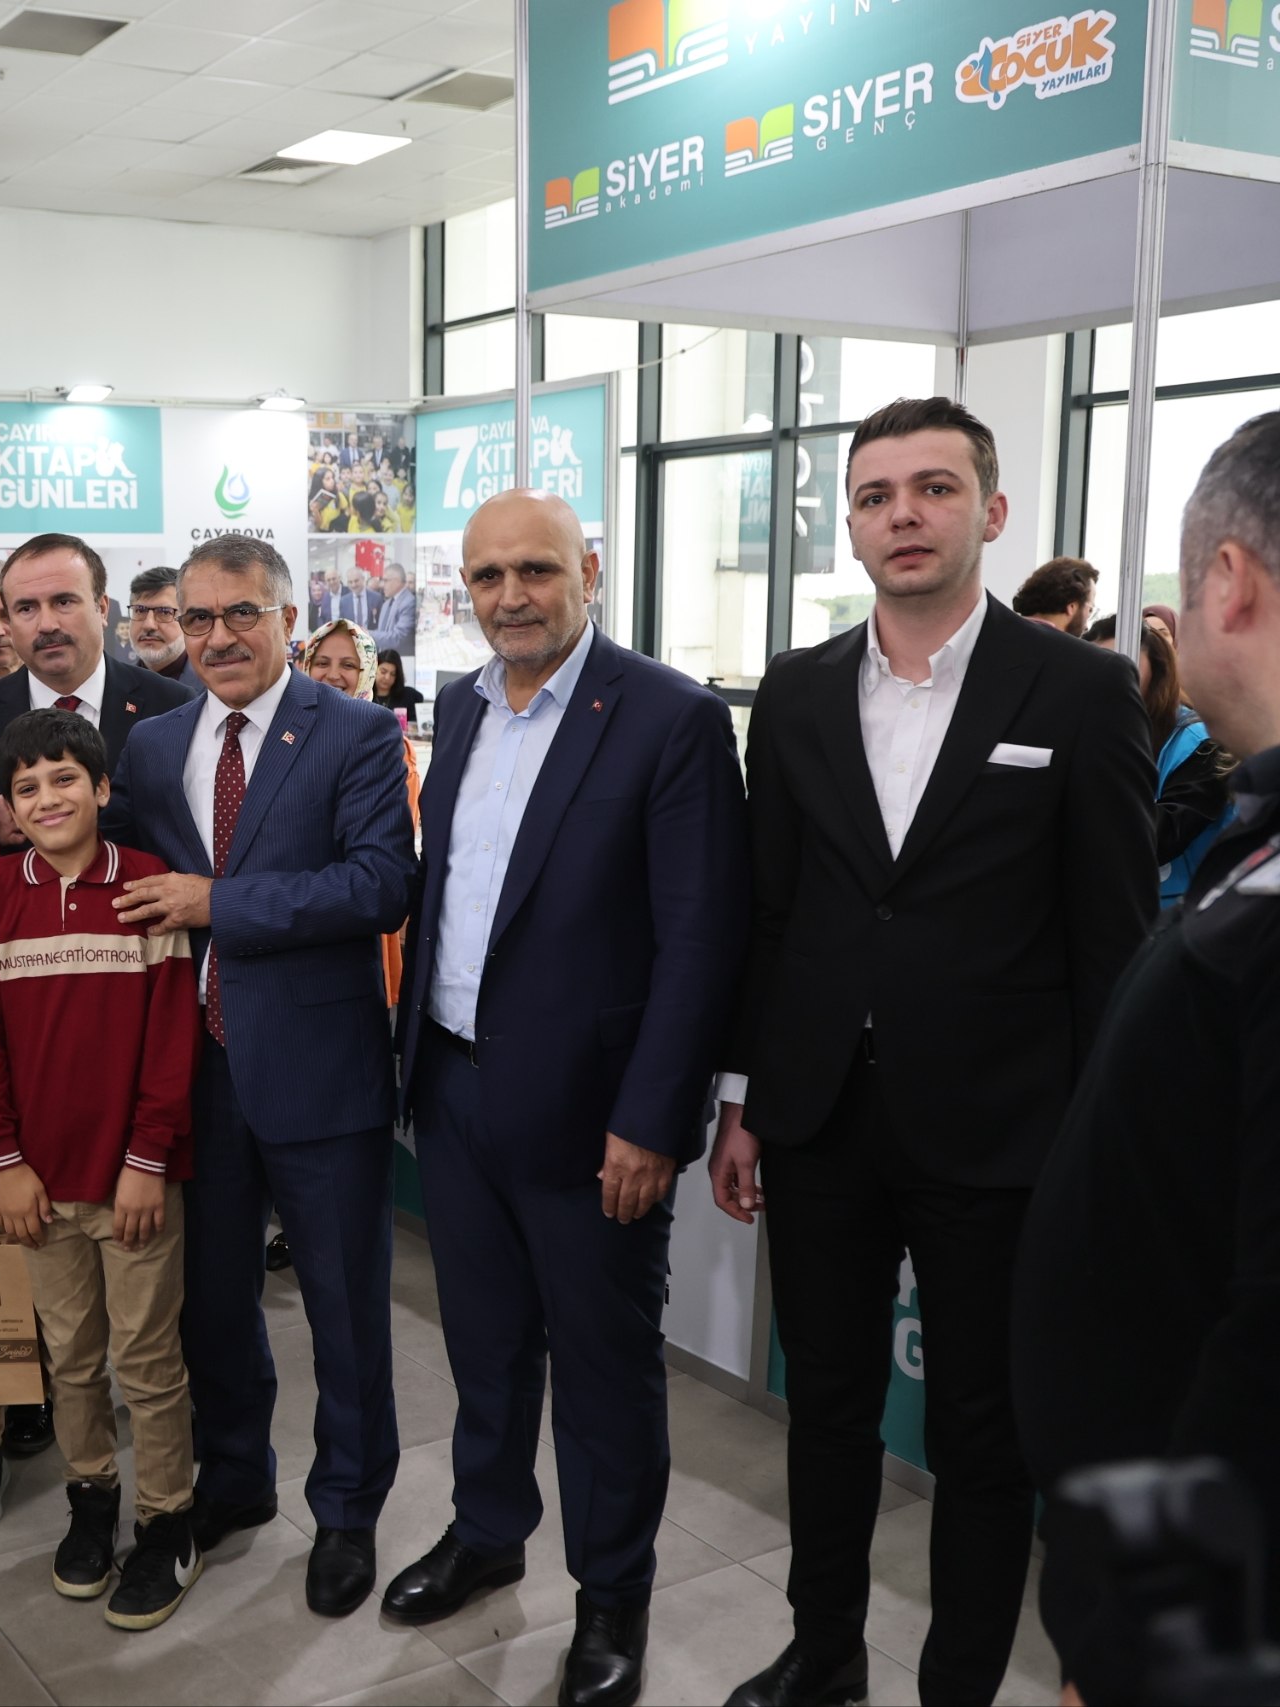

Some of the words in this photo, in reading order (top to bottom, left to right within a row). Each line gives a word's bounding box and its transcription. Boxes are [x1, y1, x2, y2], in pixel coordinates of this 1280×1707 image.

[744, 0, 901, 55] YAYIN
[1041, 62, 1107, 93] YAYINLARI
[816, 110, 917, 152] GENÇ
[605, 171, 704, 214] akademi
[434, 425, 477, 510] 7.
[476, 437, 551, 475] KİTP
